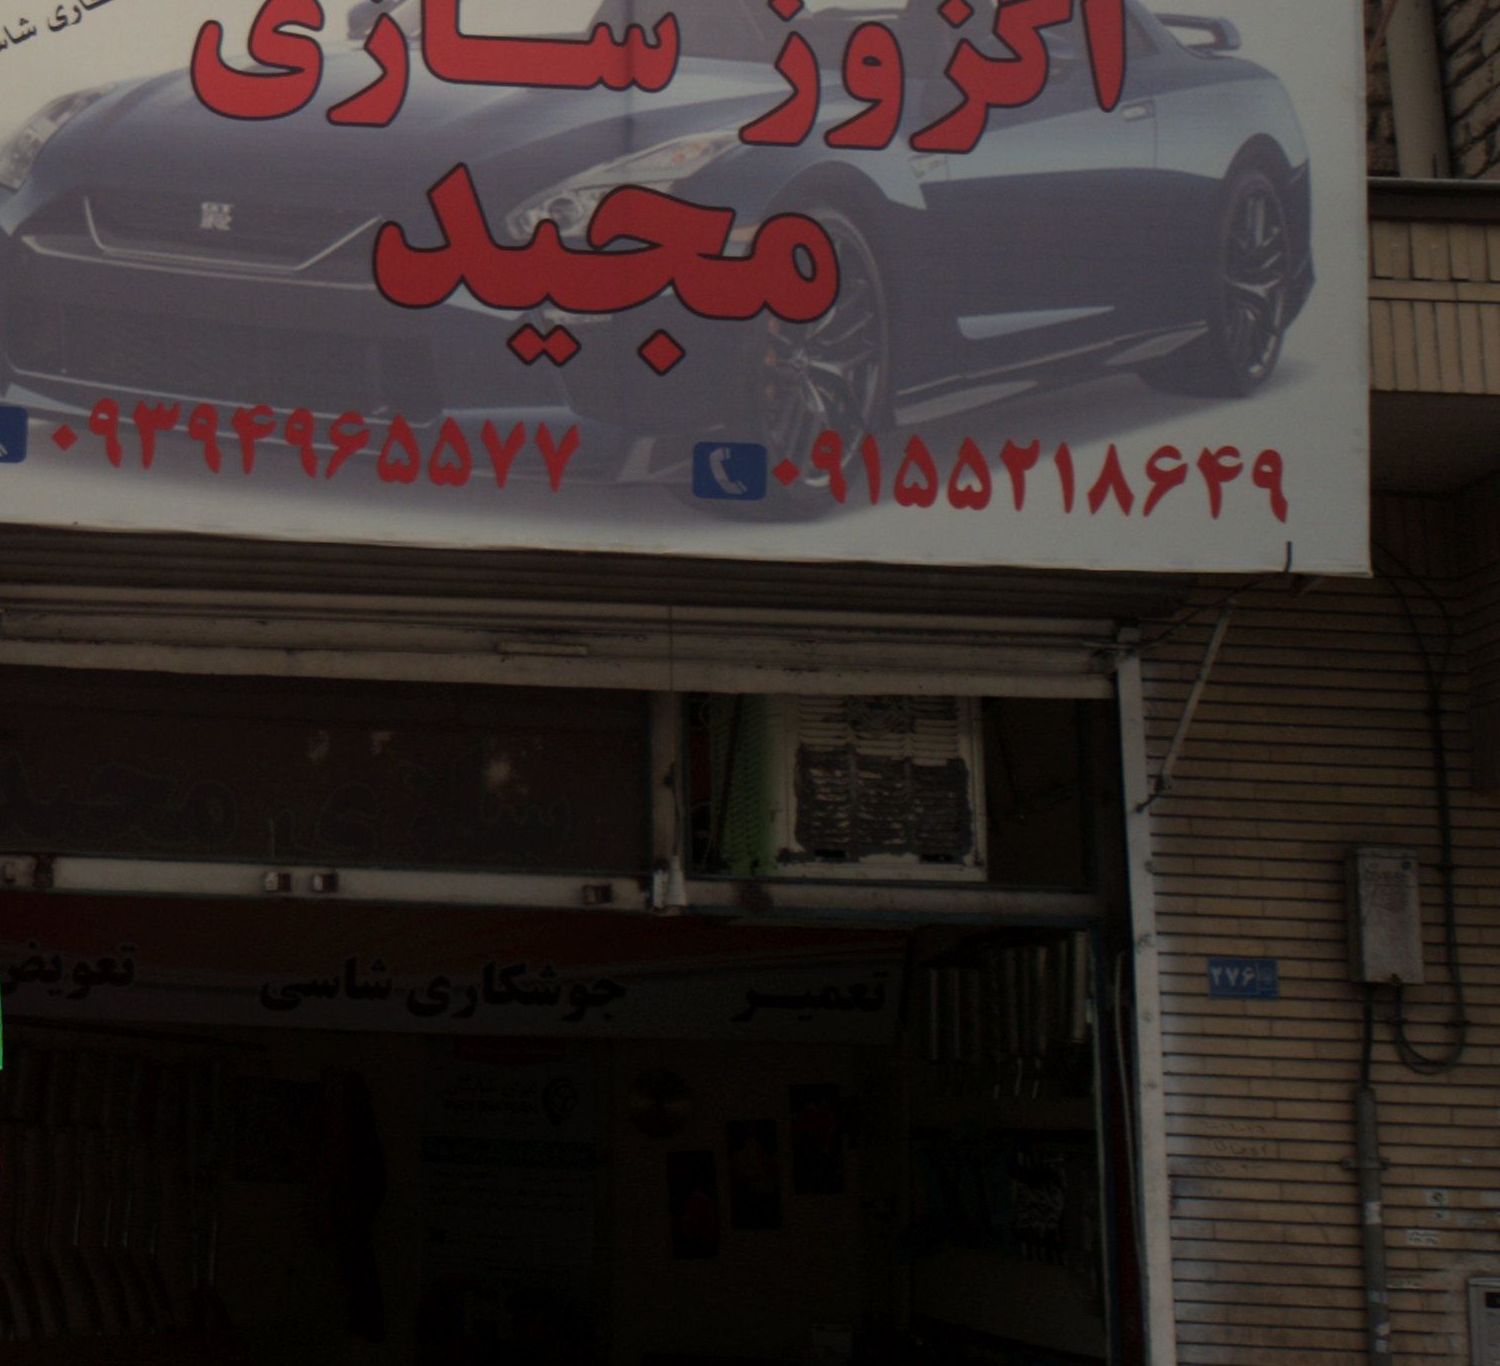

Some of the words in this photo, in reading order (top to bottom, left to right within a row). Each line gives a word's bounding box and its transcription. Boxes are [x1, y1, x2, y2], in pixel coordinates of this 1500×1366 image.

[371, 161, 842, 376] مجید
[50, 396, 582, 493] ۰۹۳۹۴۹۶۵۵۷۷
[770, 428, 1289, 524] ۰۹۱۵۵۲۱۸۶۴۹
[260, 956, 393, 1011] شاسی
[406, 960, 628, 1022] جوشکاری
[730, 971, 886, 1022] تعمیر
